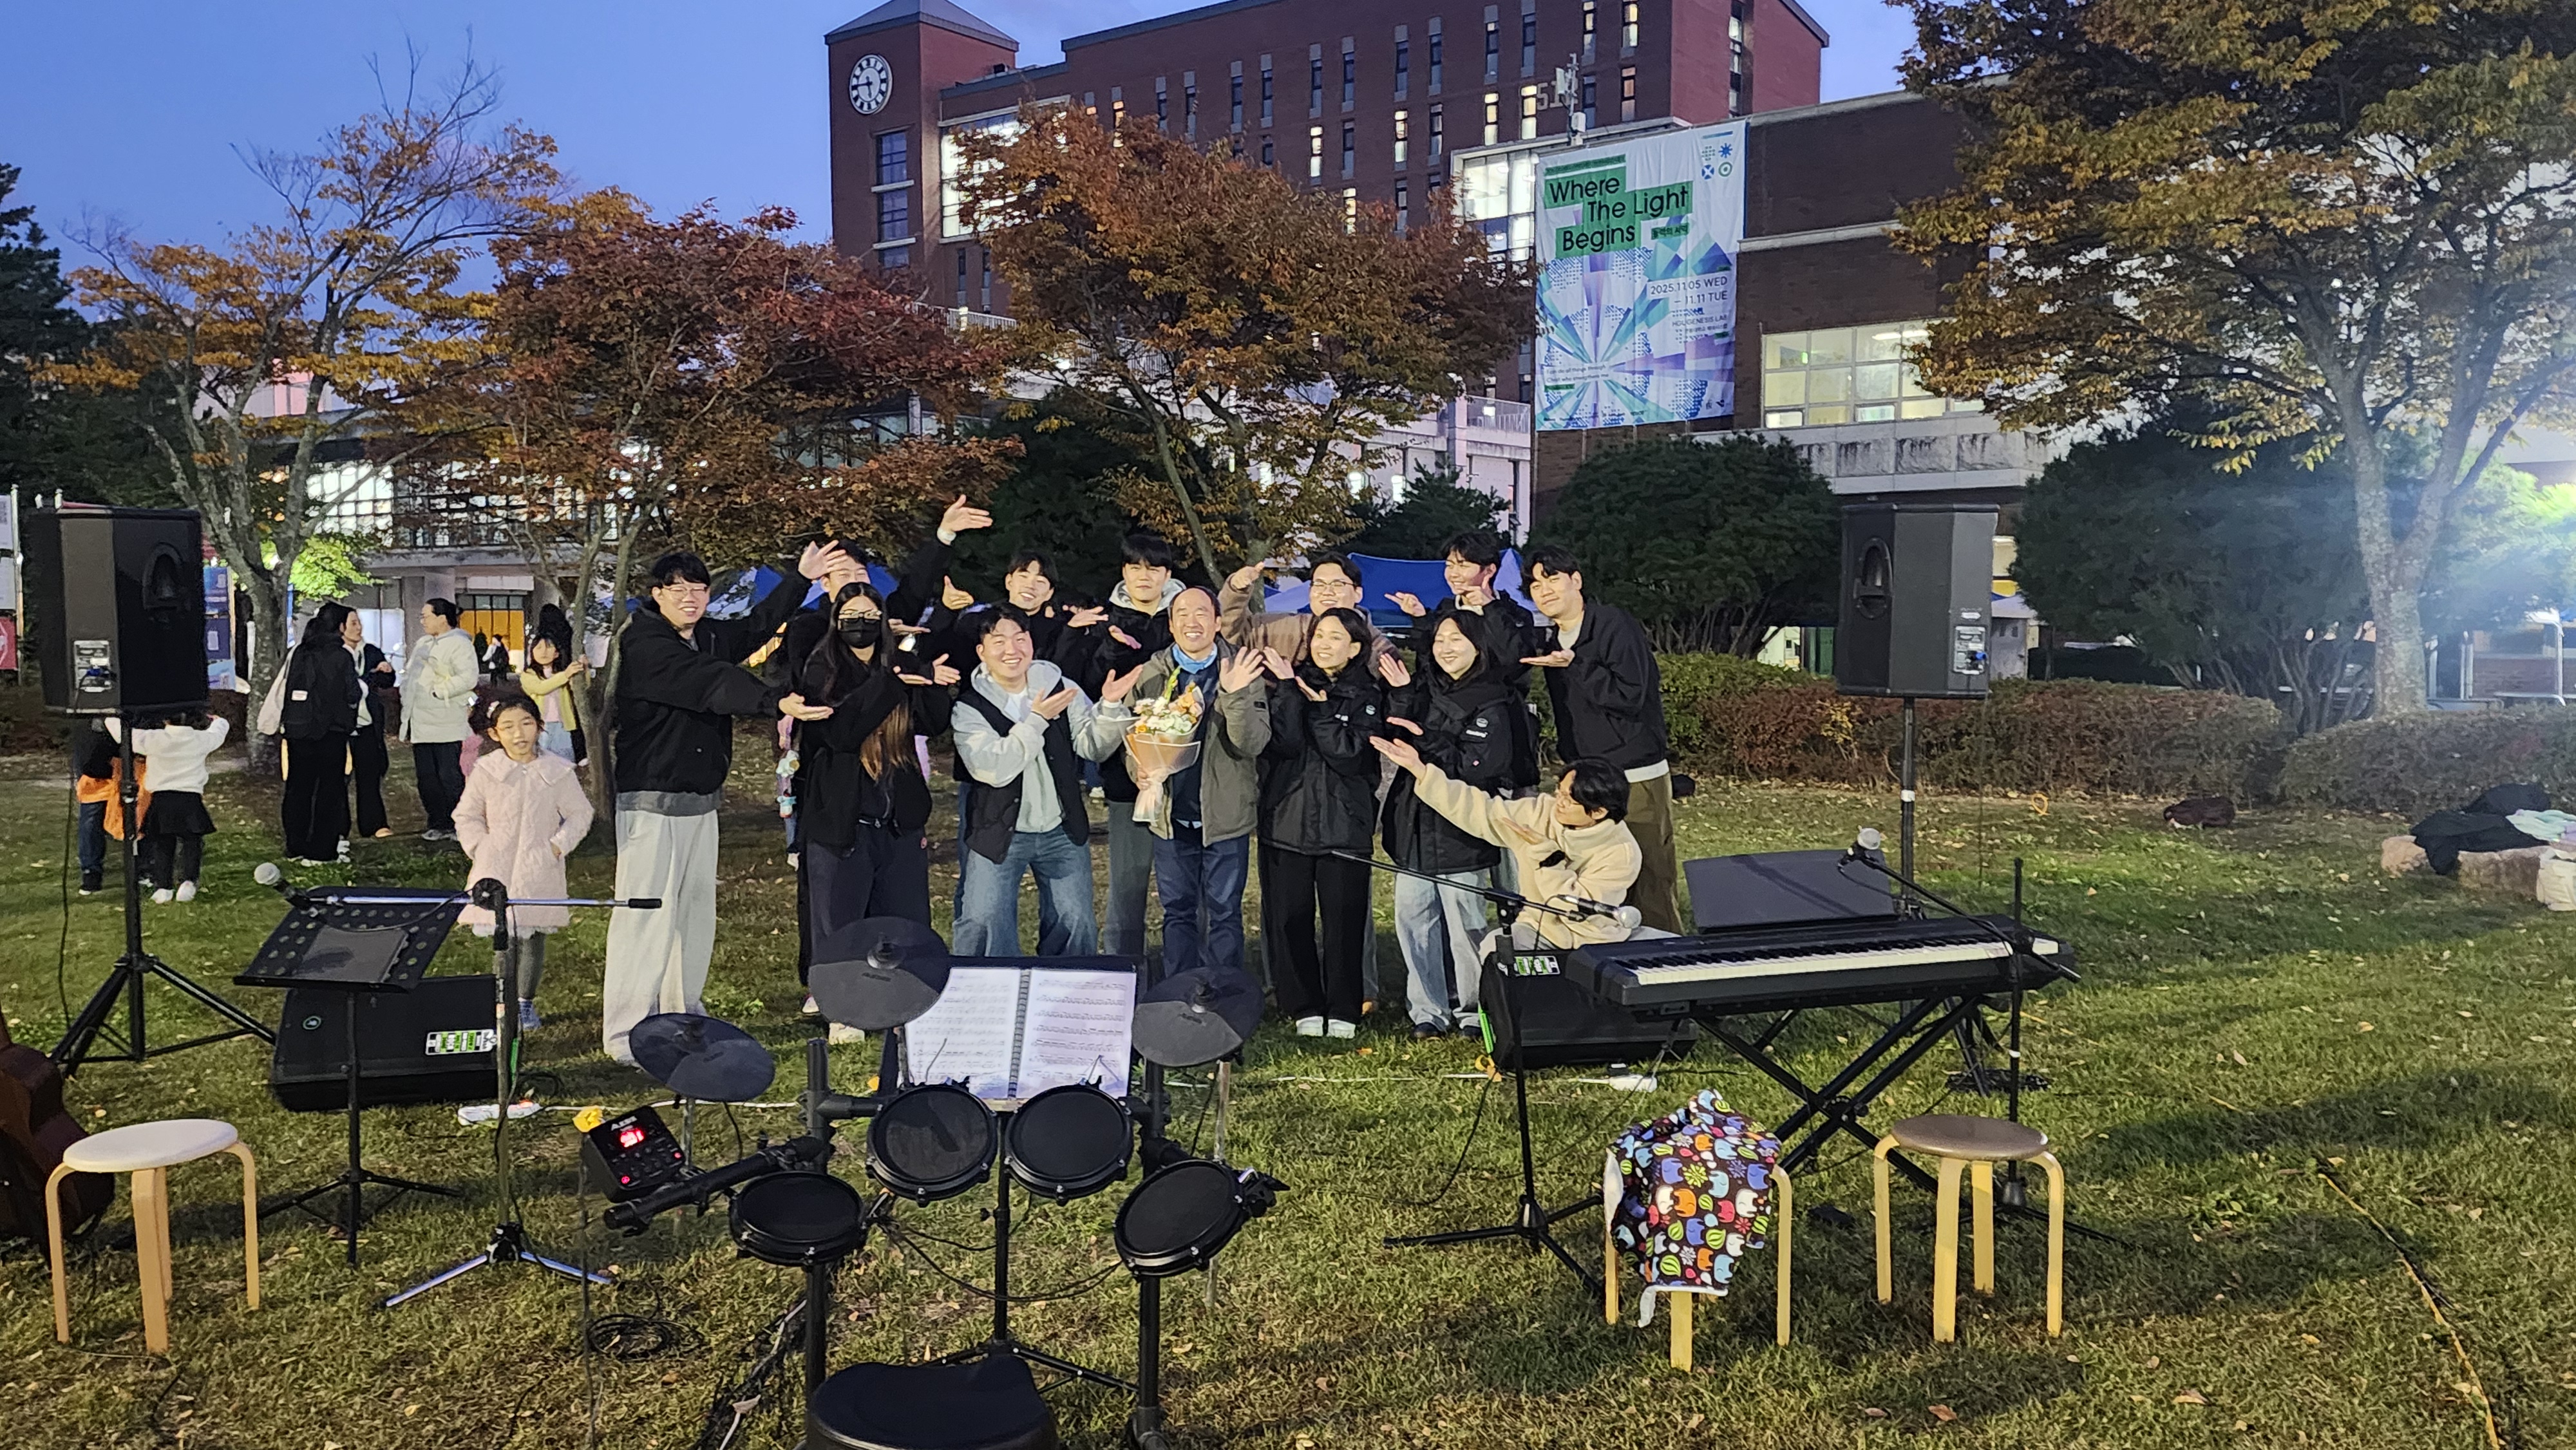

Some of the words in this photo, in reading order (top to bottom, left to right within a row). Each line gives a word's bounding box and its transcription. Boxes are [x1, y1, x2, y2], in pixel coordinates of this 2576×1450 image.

[1549, 178, 1620, 203] Where
[1587, 200, 1625, 222] The
[1634, 185, 1688, 218] Light
[1563, 225, 1635, 252] Begins
[1651, 279, 1701, 295] 2025.1105
[1704, 276, 1728, 288] WED
[1708, 290, 1728, 302] TUE
